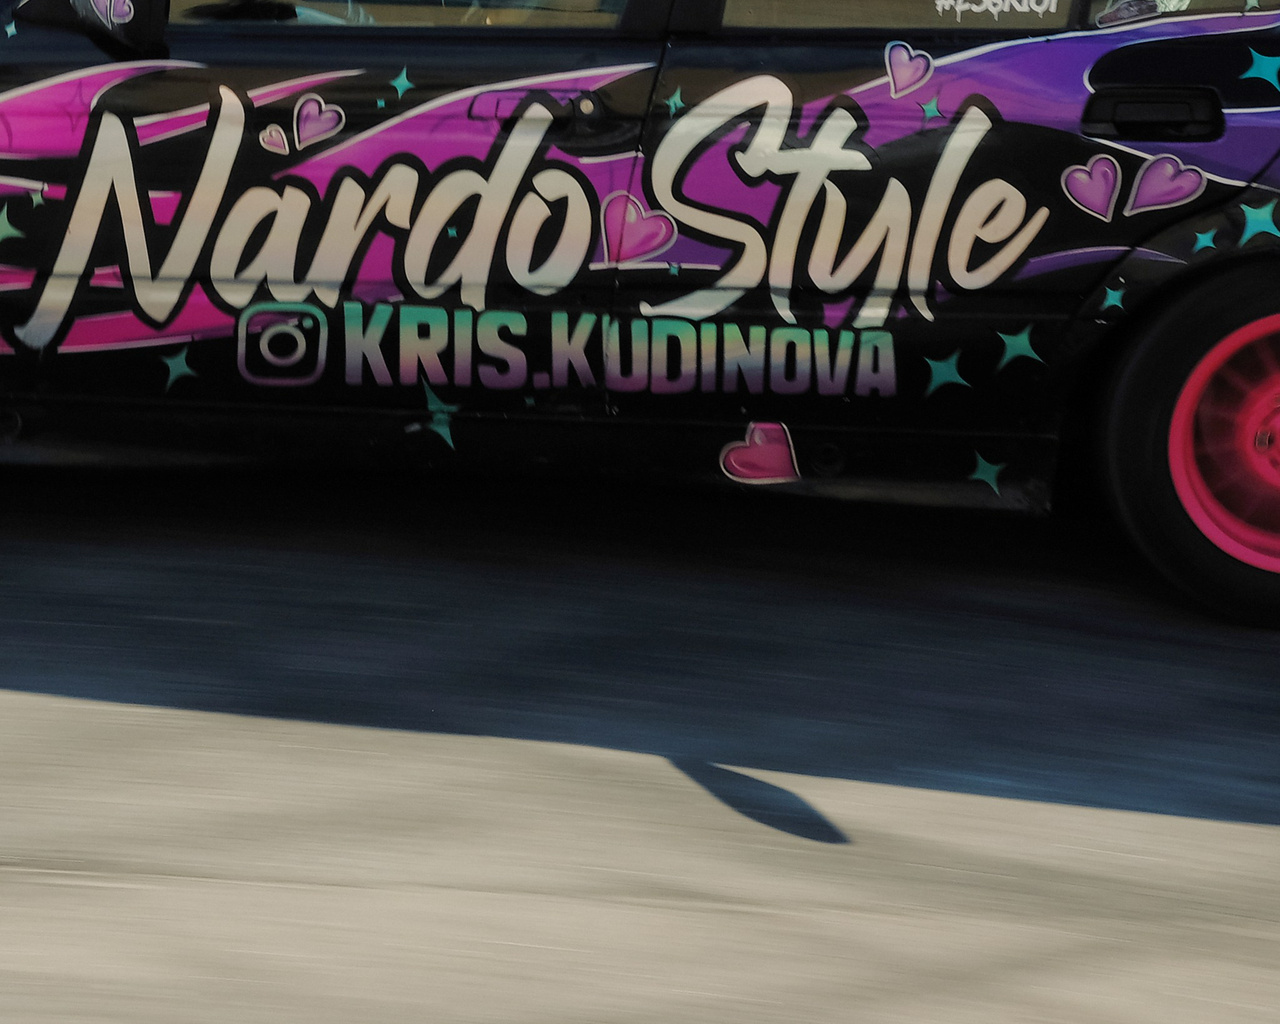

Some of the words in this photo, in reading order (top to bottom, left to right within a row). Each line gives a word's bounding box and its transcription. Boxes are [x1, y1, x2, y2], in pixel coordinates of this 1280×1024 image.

[14, 84, 593, 350] Nardo
[640, 75, 1050, 329] Style
[343, 301, 897, 397] KRIS.KUDINOVA
